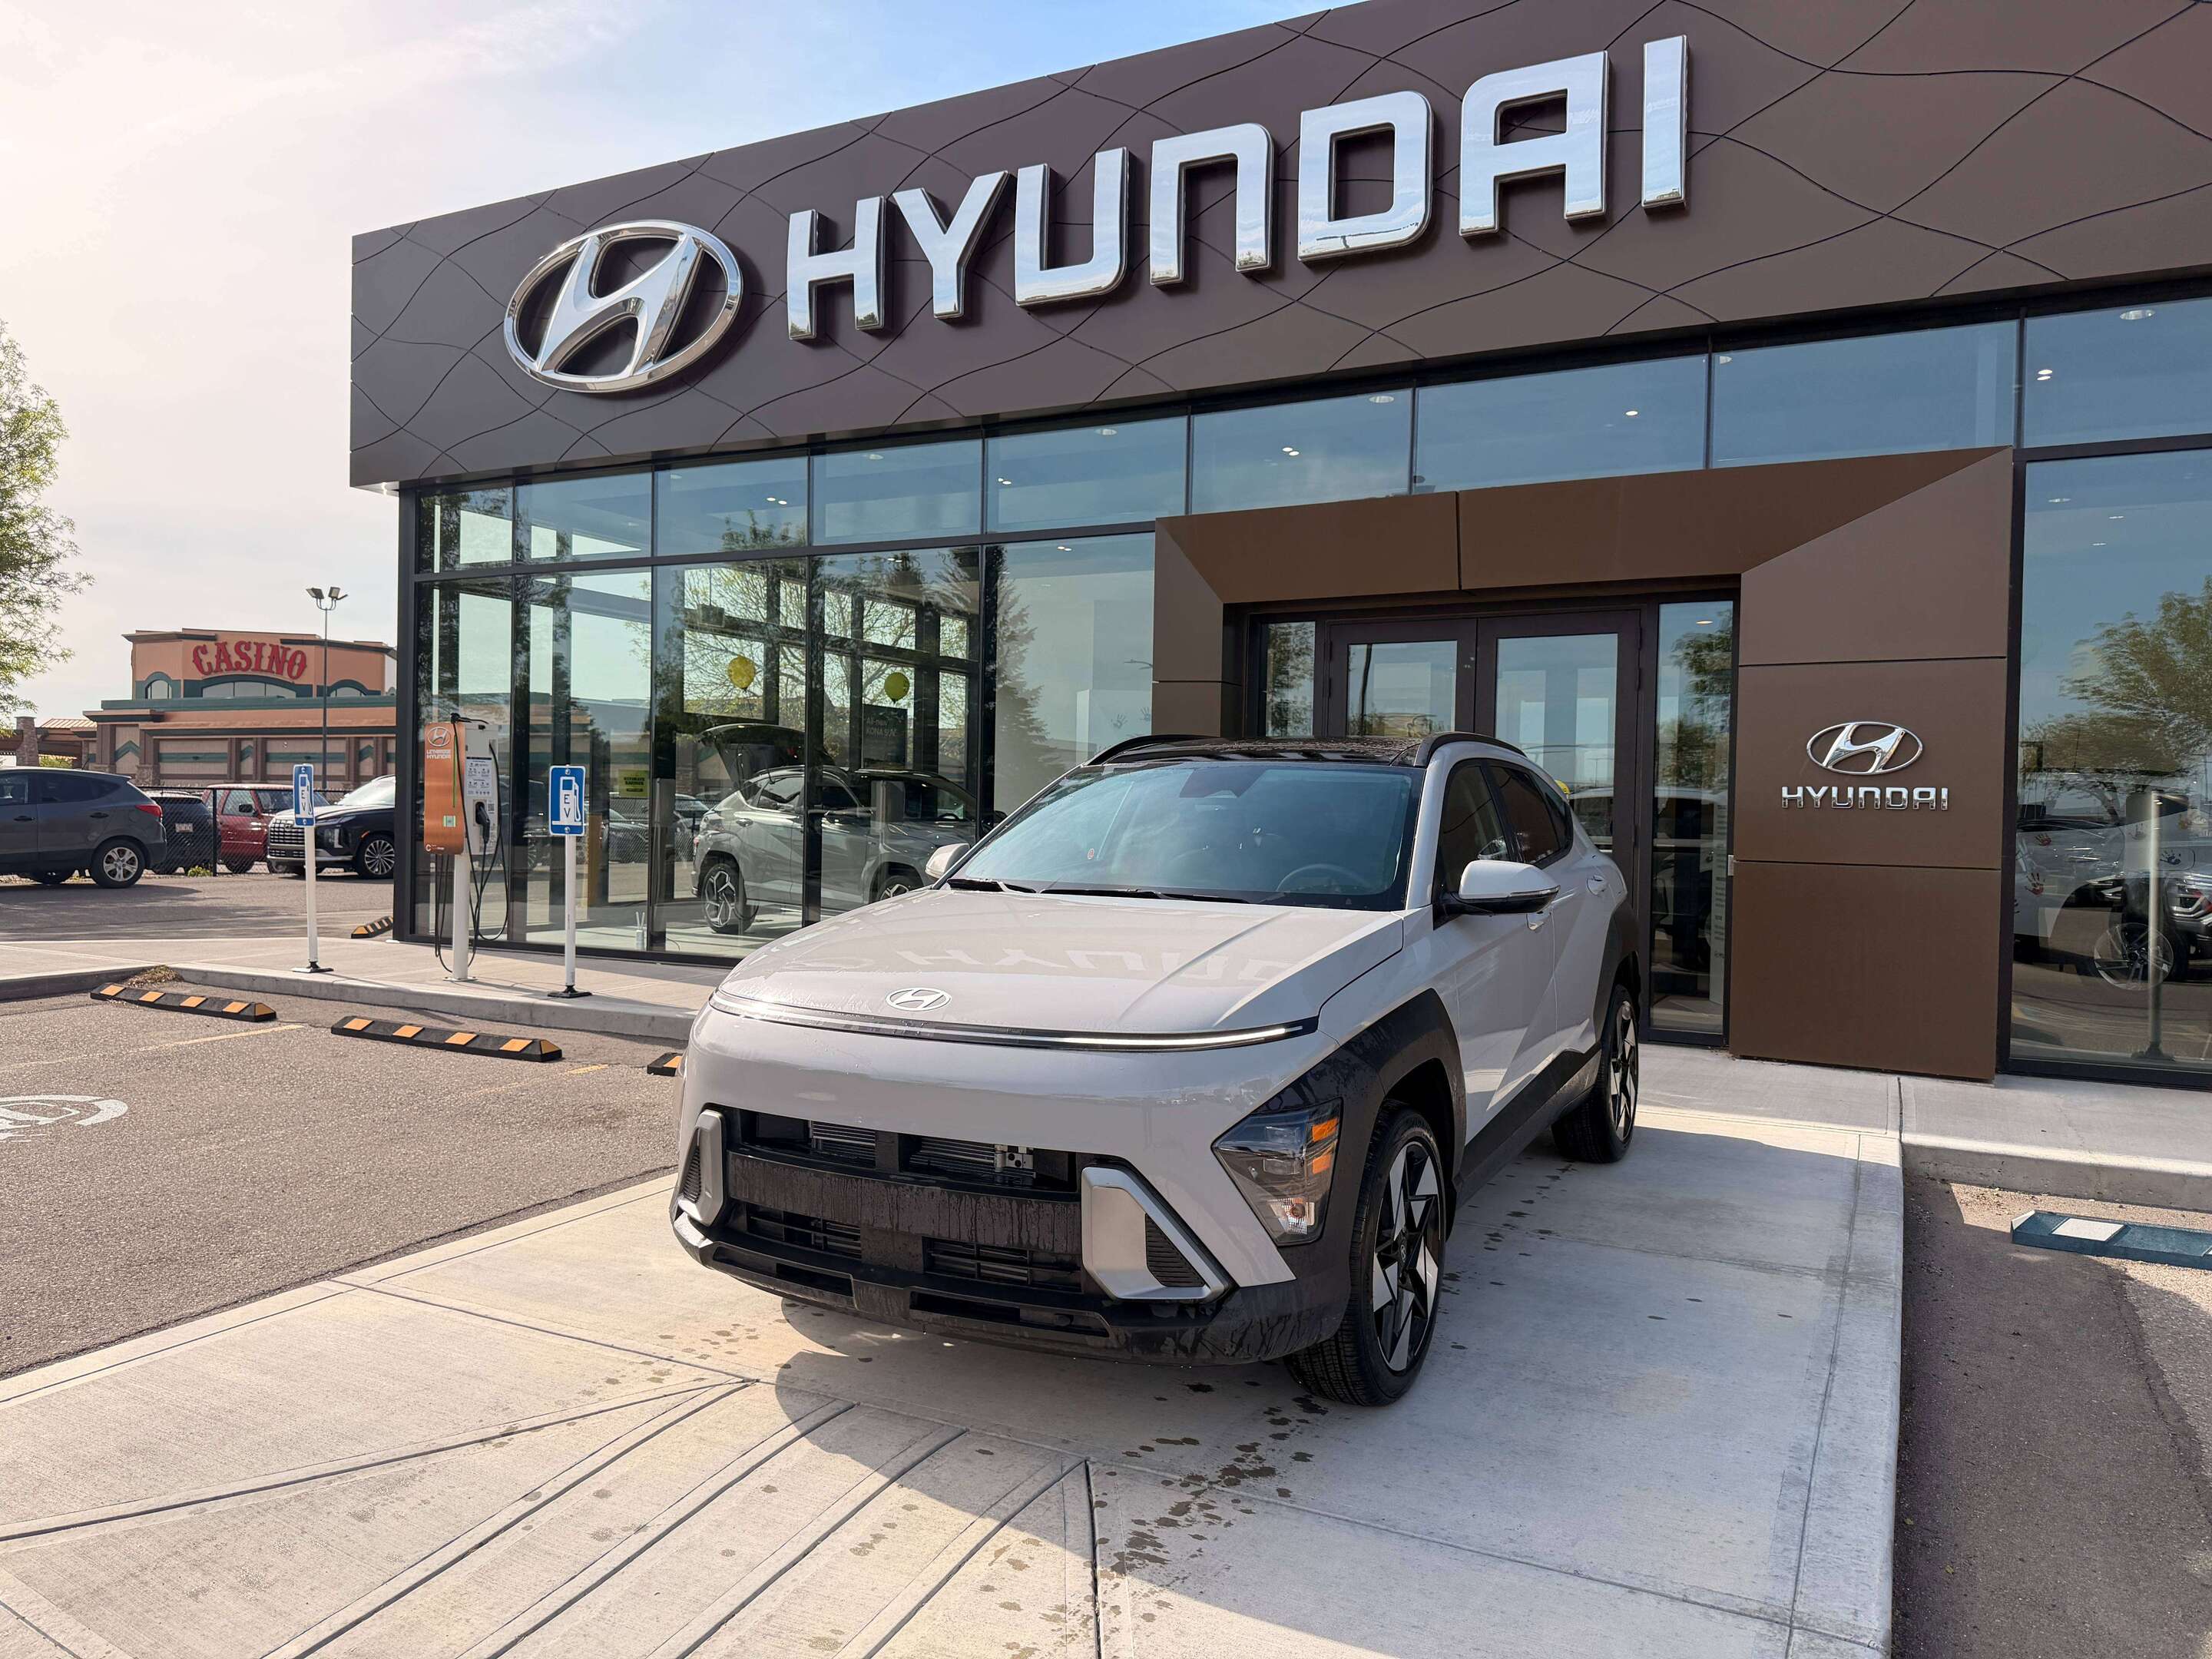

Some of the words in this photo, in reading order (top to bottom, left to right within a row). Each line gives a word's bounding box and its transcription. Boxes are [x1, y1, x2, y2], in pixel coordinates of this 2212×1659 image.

[786, 35, 1688, 341] HYUNDAI
[193, 641, 307, 680] CASINO
[1781, 786, 1949, 810] HYUNDAI
